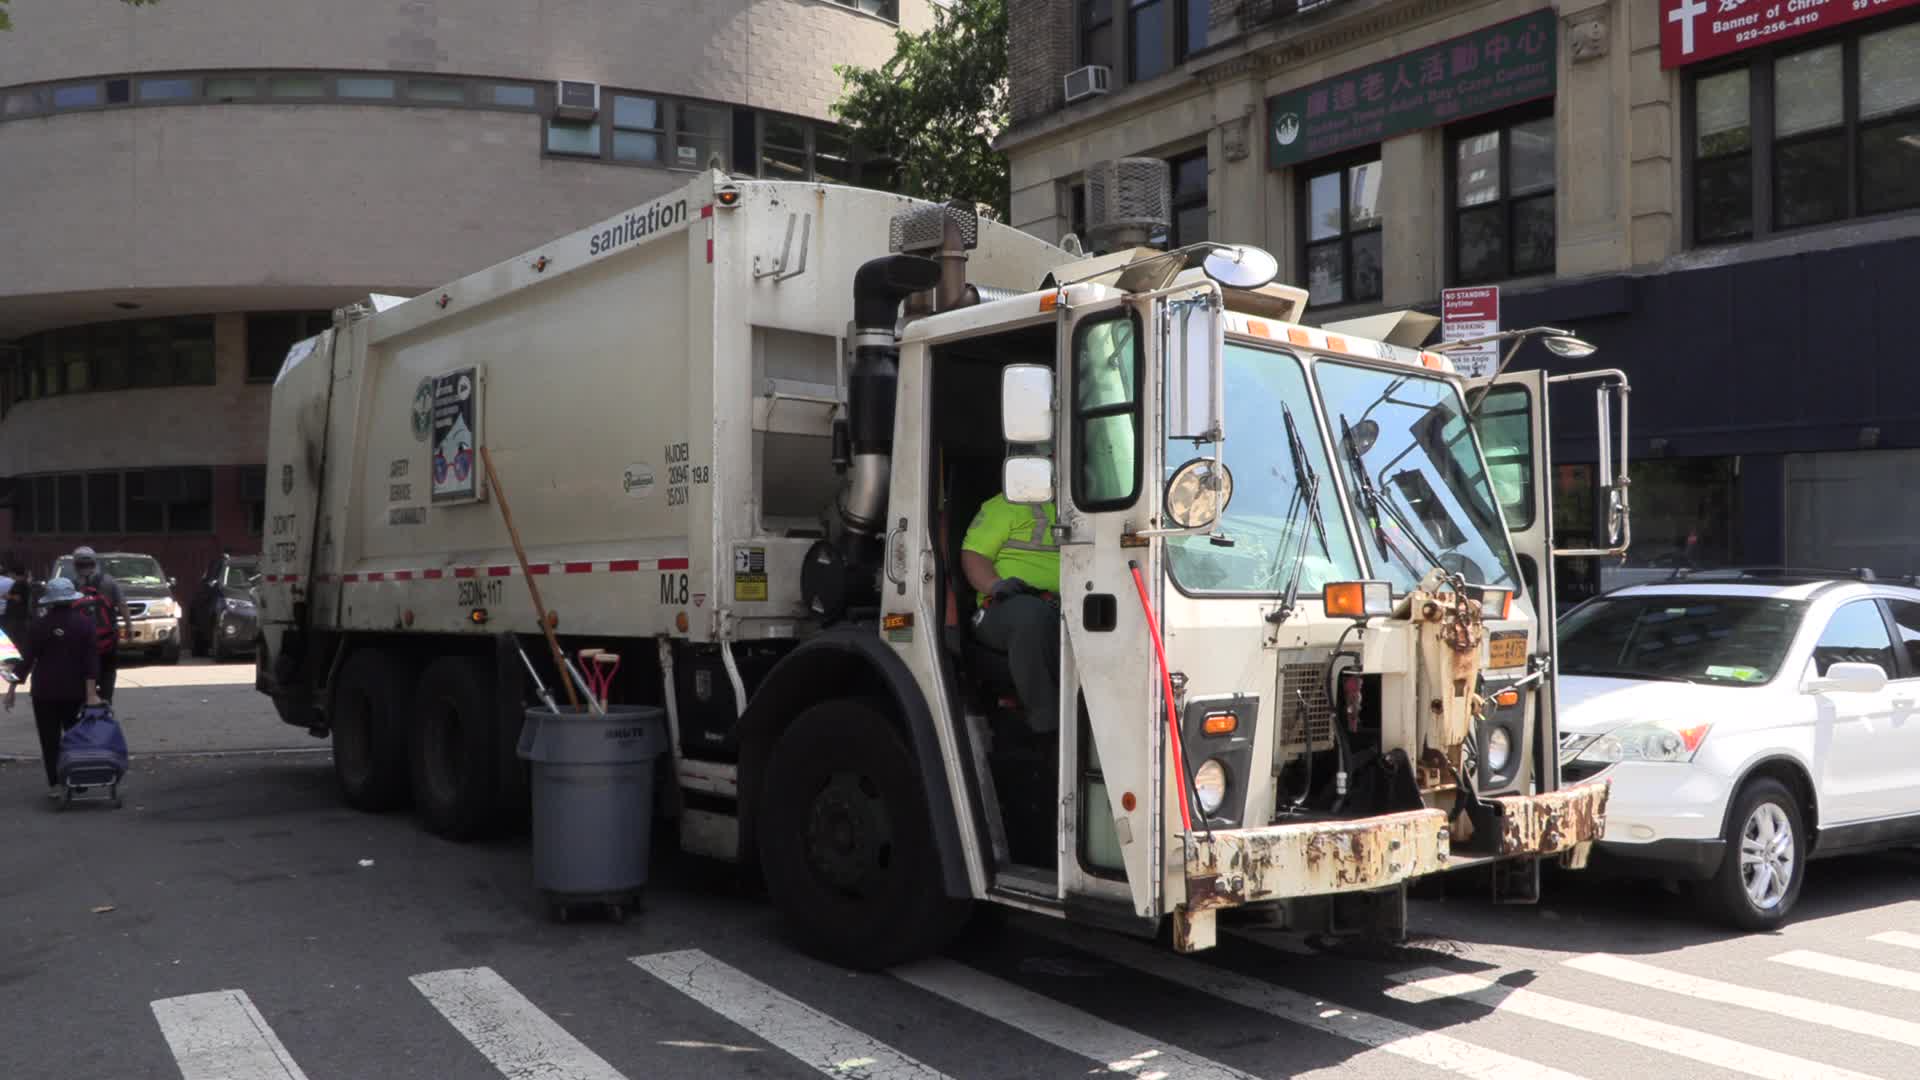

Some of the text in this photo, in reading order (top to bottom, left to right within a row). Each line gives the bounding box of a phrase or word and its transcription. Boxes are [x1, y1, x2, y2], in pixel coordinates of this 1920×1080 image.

[1712, 0, 1831, 33] Banner of Chris
[1852, 1, 1869, 10] 99
[1736, 12, 1819, 42] 929-256-4110
[590, 200, 687, 256] sanitation
[1446, 301, 1473, 309] Anytime
[1457, 290, 1490, 299] STANDING
[692, 466, 710, 484] 19.8
[660, 573, 689, 604] M.8
